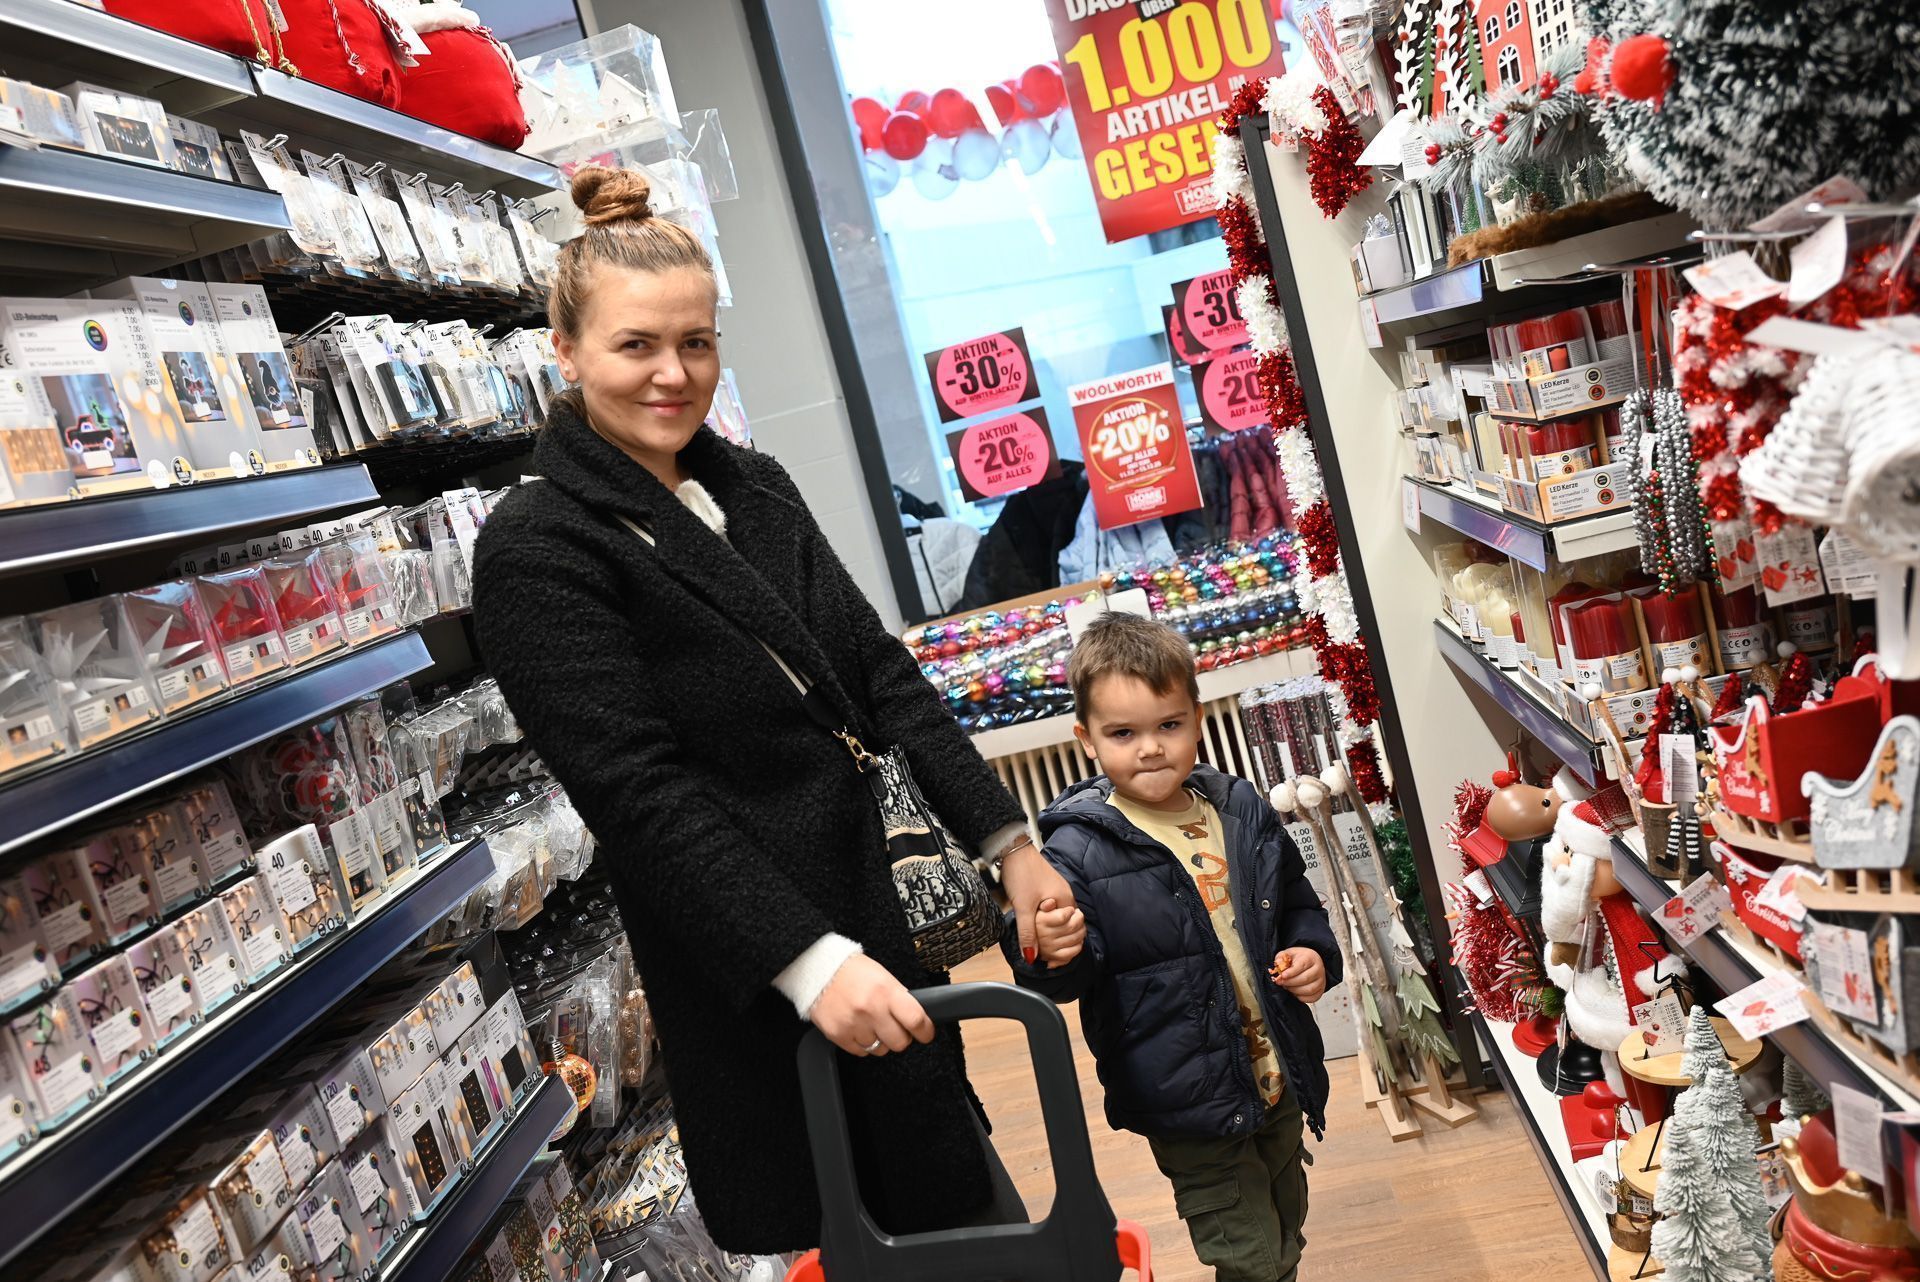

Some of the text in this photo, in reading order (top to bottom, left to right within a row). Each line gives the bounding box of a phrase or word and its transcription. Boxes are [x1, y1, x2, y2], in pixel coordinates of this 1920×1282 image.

[1064, 0, 1272, 112] 1.000
[1107, 83, 1229, 143] ARTIKEL
[335, 330, 348, 343] 20
[954, 338, 998, 362] AKTION
[946, 355, 1021, 396] -30%
[1224, 358, 1256, 375] AKTIO
[1074, 371, 1163, 401] WOOLWORTH
[1540, 378, 1570, 390] LED Kerze
[1103, 401, 1147, 426] AKTION
[978, 422, 1019, 442] AKTION
[974, 437, 1034, 473] -20%
[987, 465, 1032, 485] AUF ALLES
[1549, 482, 1579, 494] LED Kerze
[282, 536, 293, 550] 40
[312, 529, 323, 543] 40
[220, 551, 230, 565] 40
[251, 544, 263, 557] 40
[184, 560, 197, 575] 40
[1293, 827, 1310, 836] 1.00
[271, 852, 285, 870] 40
[322, 1081, 338, 1101] 120
[275, 1124, 288, 1143] 20
